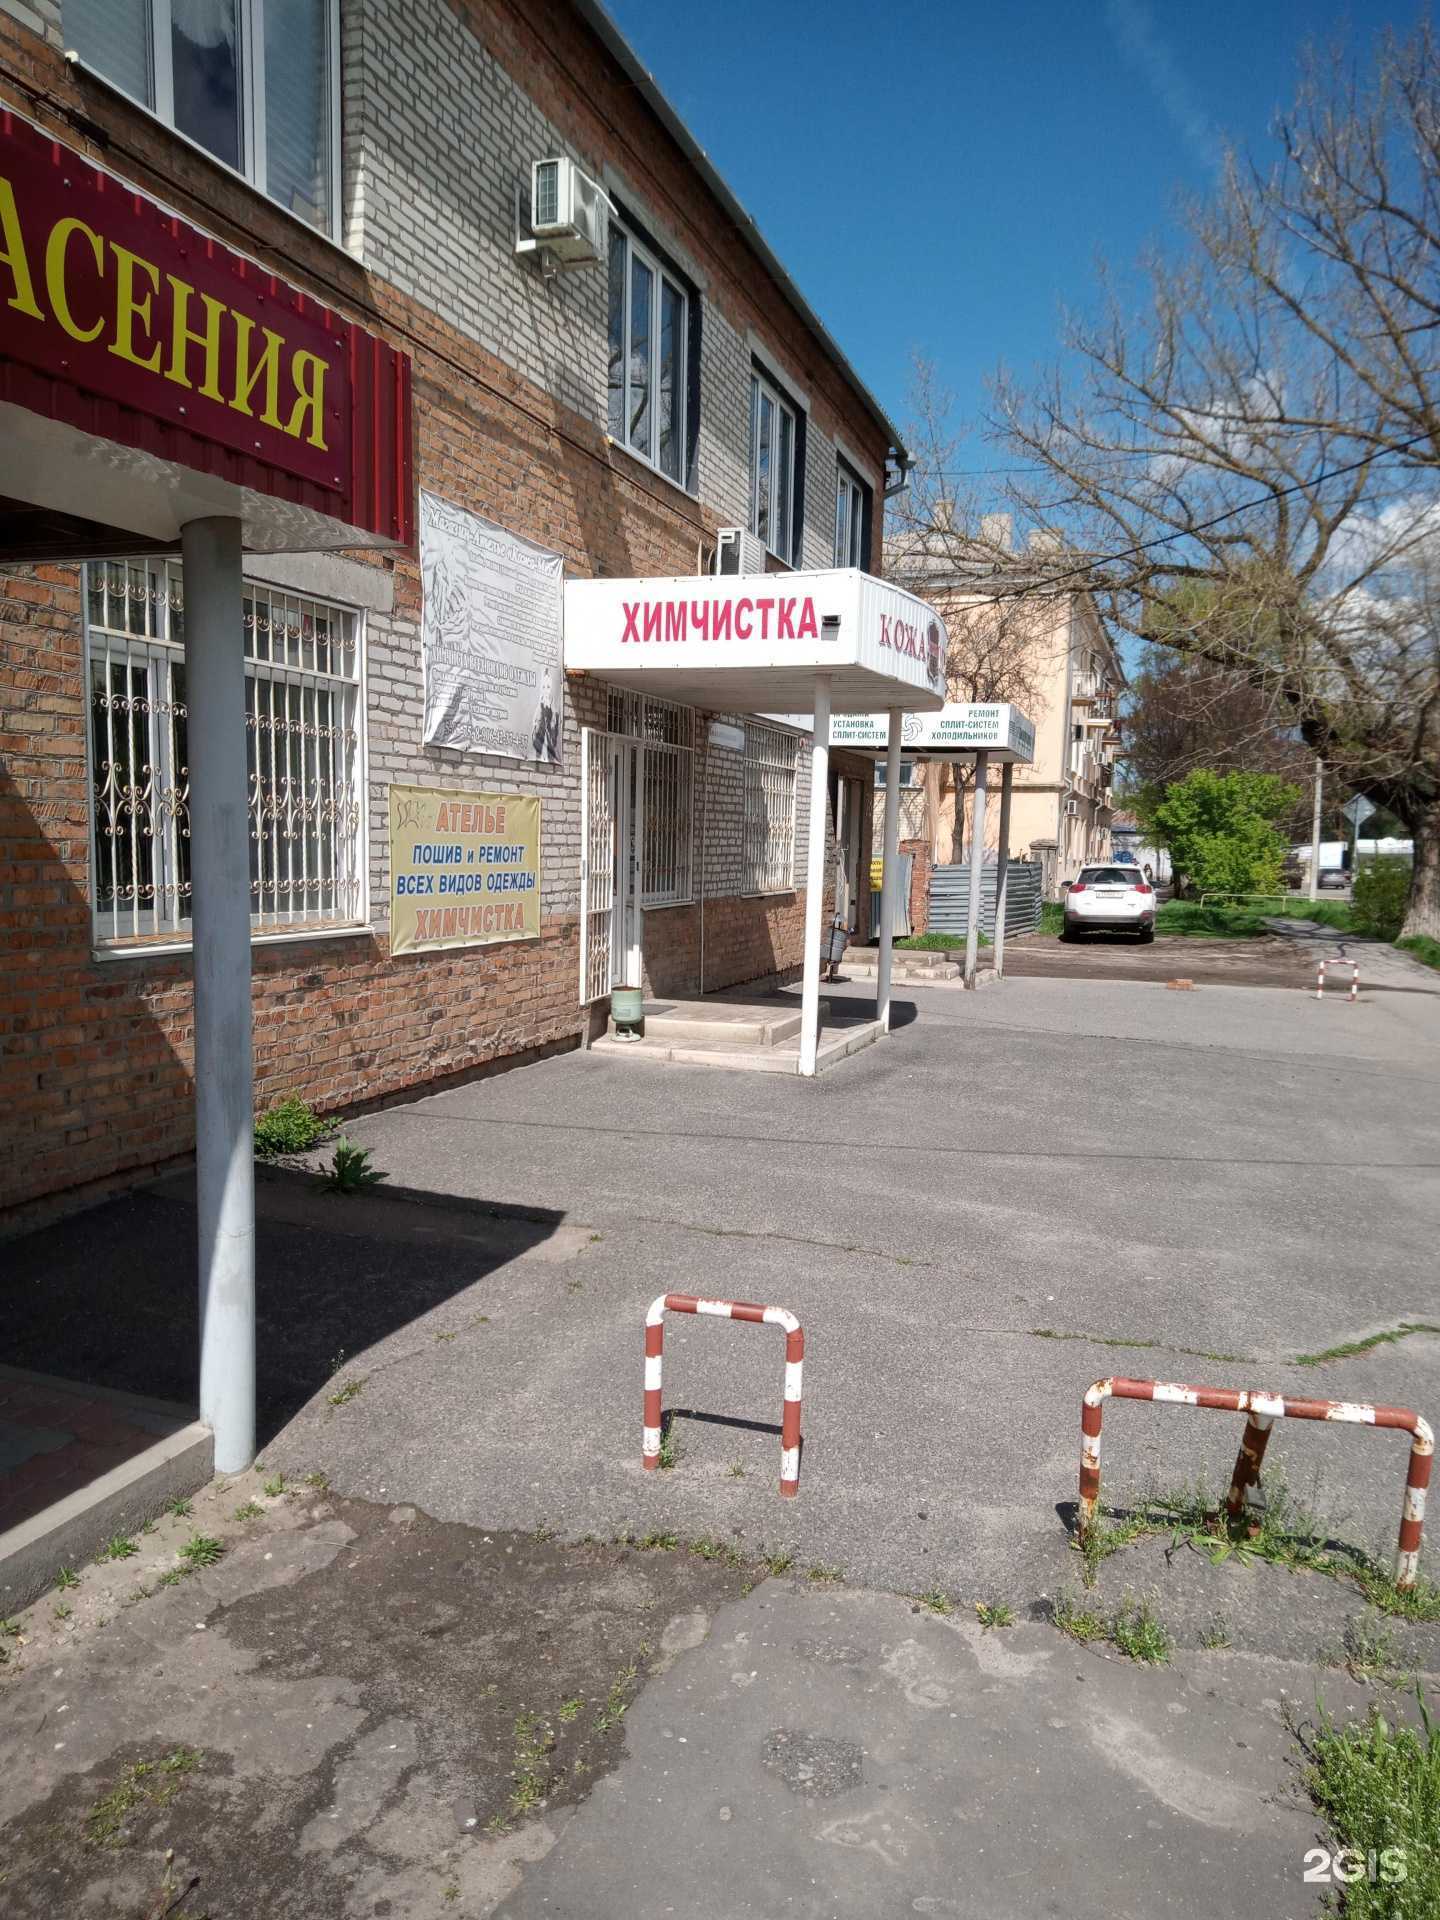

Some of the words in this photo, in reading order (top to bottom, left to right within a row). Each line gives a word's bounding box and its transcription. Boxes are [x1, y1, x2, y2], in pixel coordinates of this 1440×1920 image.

[621, 597, 818, 643] ХИМЧИСТКА
[879, 614, 927, 662] КОЖА
[968, 709, 1000, 718] РЕМОНТ
[833, 720, 874, 728] УСТАНОВКА
[940, 720, 999, 729] СПЛИТ-СИСТЕМ
[832, 730, 886, 739] СПЛИТ-СИСТЕМ
[931, 731, 998, 740] ХОЛОДИЛЬНИКОВ
[436, 802, 506, 834] АТЕЛЬЕ
[412, 844, 462, 864] ПОШИВ
[467, 850, 474, 864] и
[478, 846, 524, 864] РЕМОНТ
[397, 874, 434, 895] ВСЕХ
[439, 874, 482, 895] ВИДОВ
[486, 872, 536, 892] ОДЕЖДЫ
[414, 903, 524, 940] ХИМЧИСТКА
